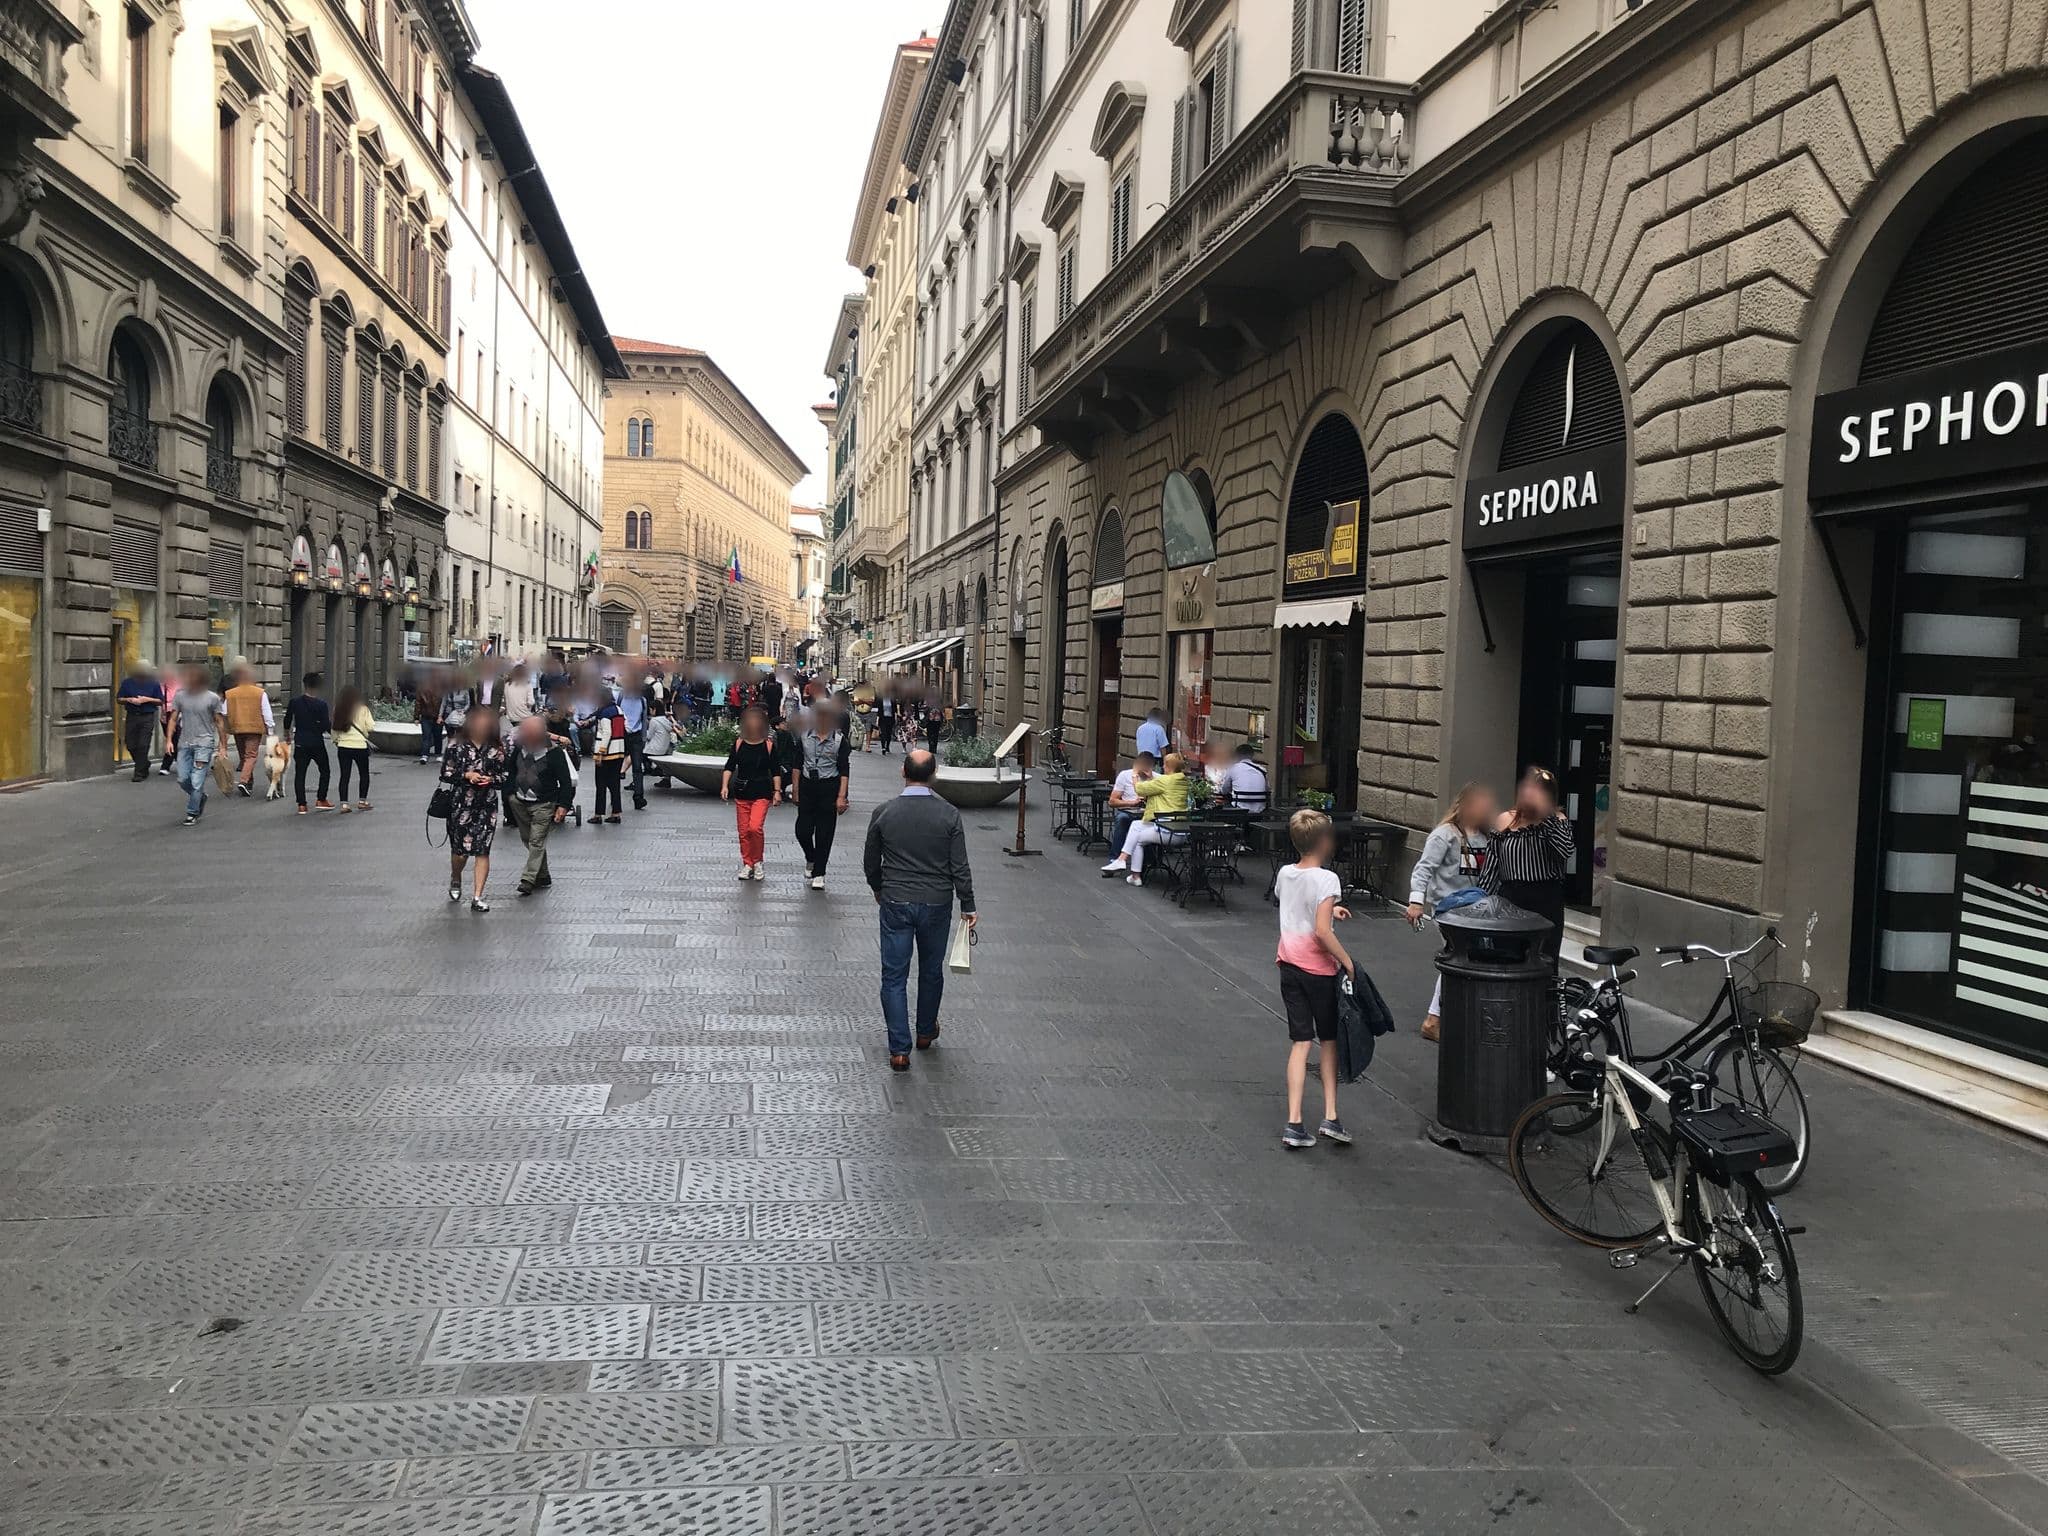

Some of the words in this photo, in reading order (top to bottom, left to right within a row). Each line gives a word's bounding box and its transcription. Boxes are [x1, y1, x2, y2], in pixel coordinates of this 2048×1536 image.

[1479, 471, 1599, 526] SEPHORA
[1288, 551, 1325, 569] SPAGHETTERIA
[1294, 566, 1318, 580] PIZZERIA
